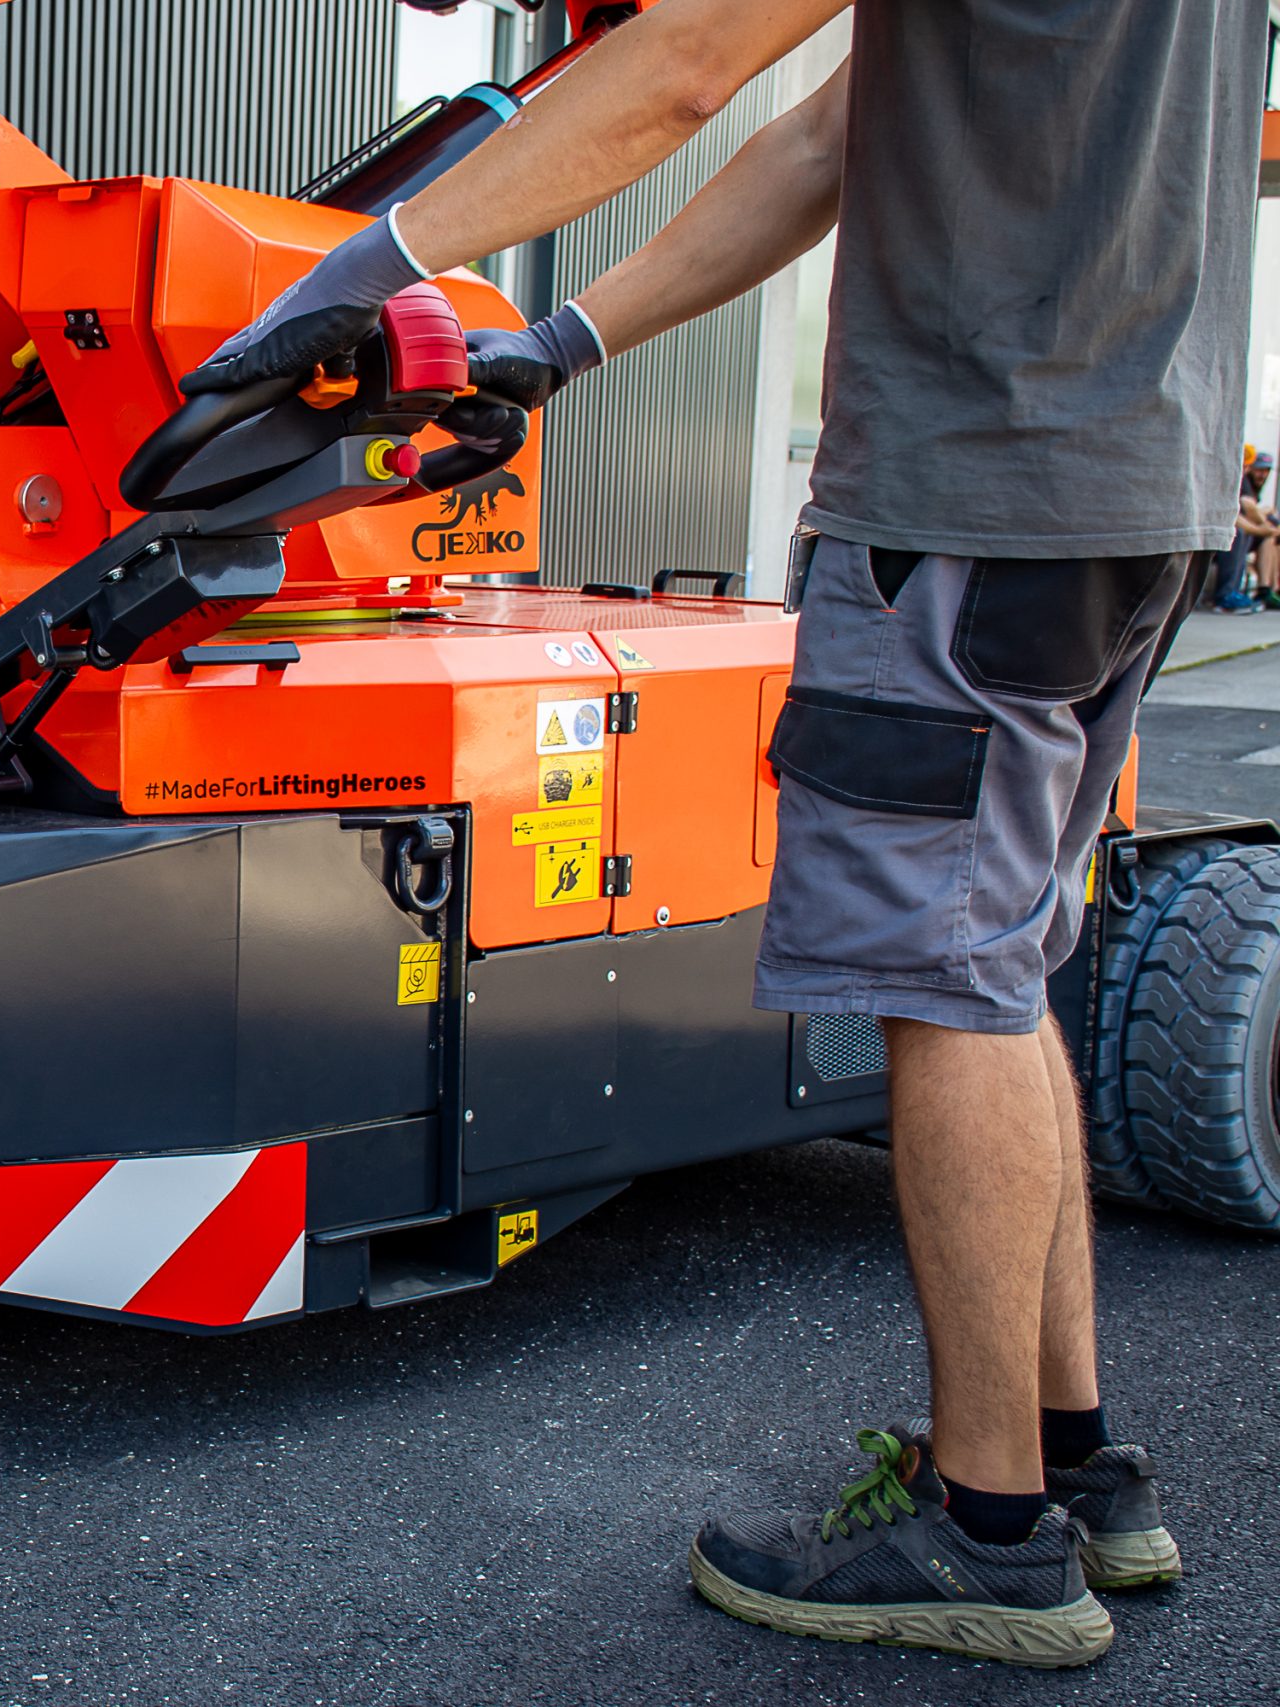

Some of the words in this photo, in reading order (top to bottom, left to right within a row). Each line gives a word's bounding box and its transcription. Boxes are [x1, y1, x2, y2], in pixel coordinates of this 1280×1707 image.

[145, 773, 426, 799] #MadeForLiftingHeroes
[538, 822, 549, 831] USB
[551, 819, 576, 830] CHARGER
[577, 817, 595, 827] INSIDE
